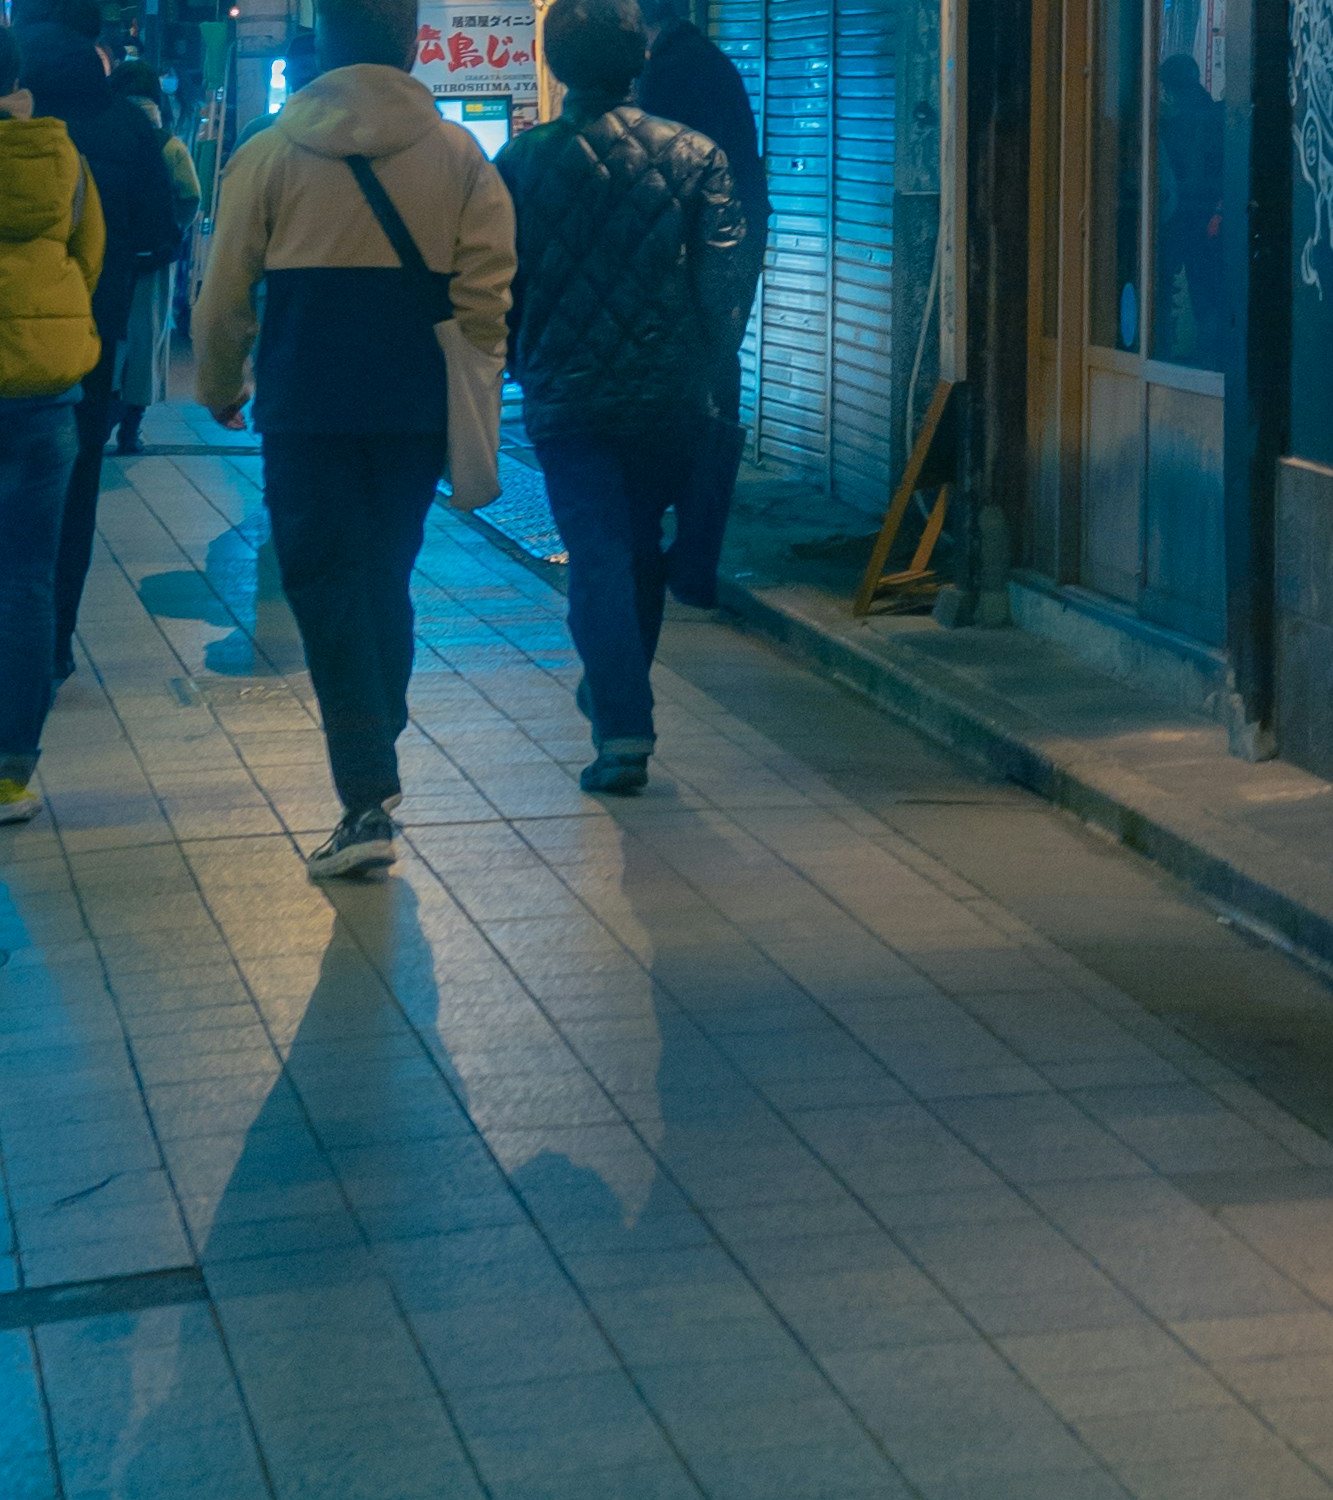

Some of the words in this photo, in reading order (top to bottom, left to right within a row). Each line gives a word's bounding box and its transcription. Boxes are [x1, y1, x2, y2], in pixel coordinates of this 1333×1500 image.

[451, 14, 538, 28] 居酒屋ダイニン
[432, 81, 510, 94] HIROSHIMA
